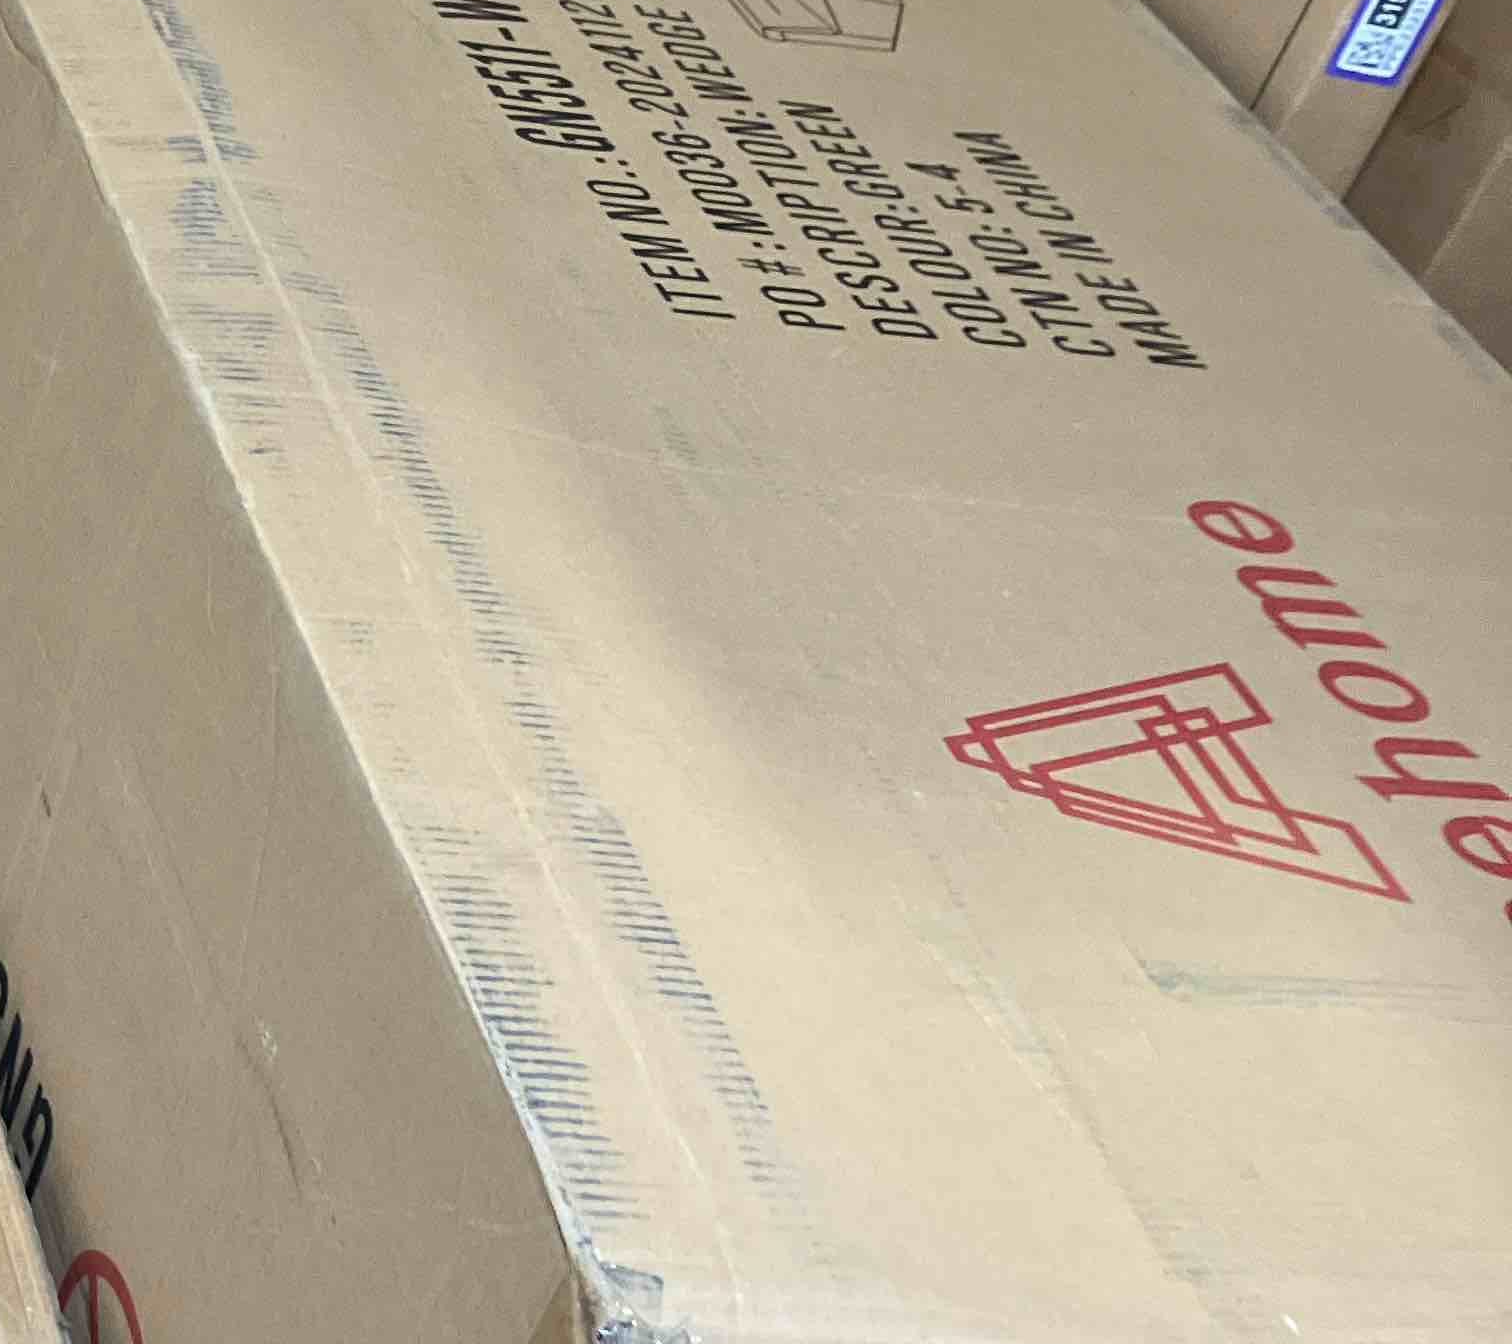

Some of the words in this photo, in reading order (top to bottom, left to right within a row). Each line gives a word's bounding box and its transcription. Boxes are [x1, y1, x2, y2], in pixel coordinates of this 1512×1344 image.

[633, 2, 754, 103] WEDGE
[903, 160, 995, 214] 5-4
[951, 130, 1076, 223] CHINA
[619, 232, 738, 320] ITEM
[969, 223, 1052, 281] NO:
[1038, 228, 1114, 265] IN
[759, 284, 848, 331] PO
[1008, 286, 1117, 358] CTN
[1075, 271, 1209, 371] MADE
[1187, 499, 1512, 929] ehome
